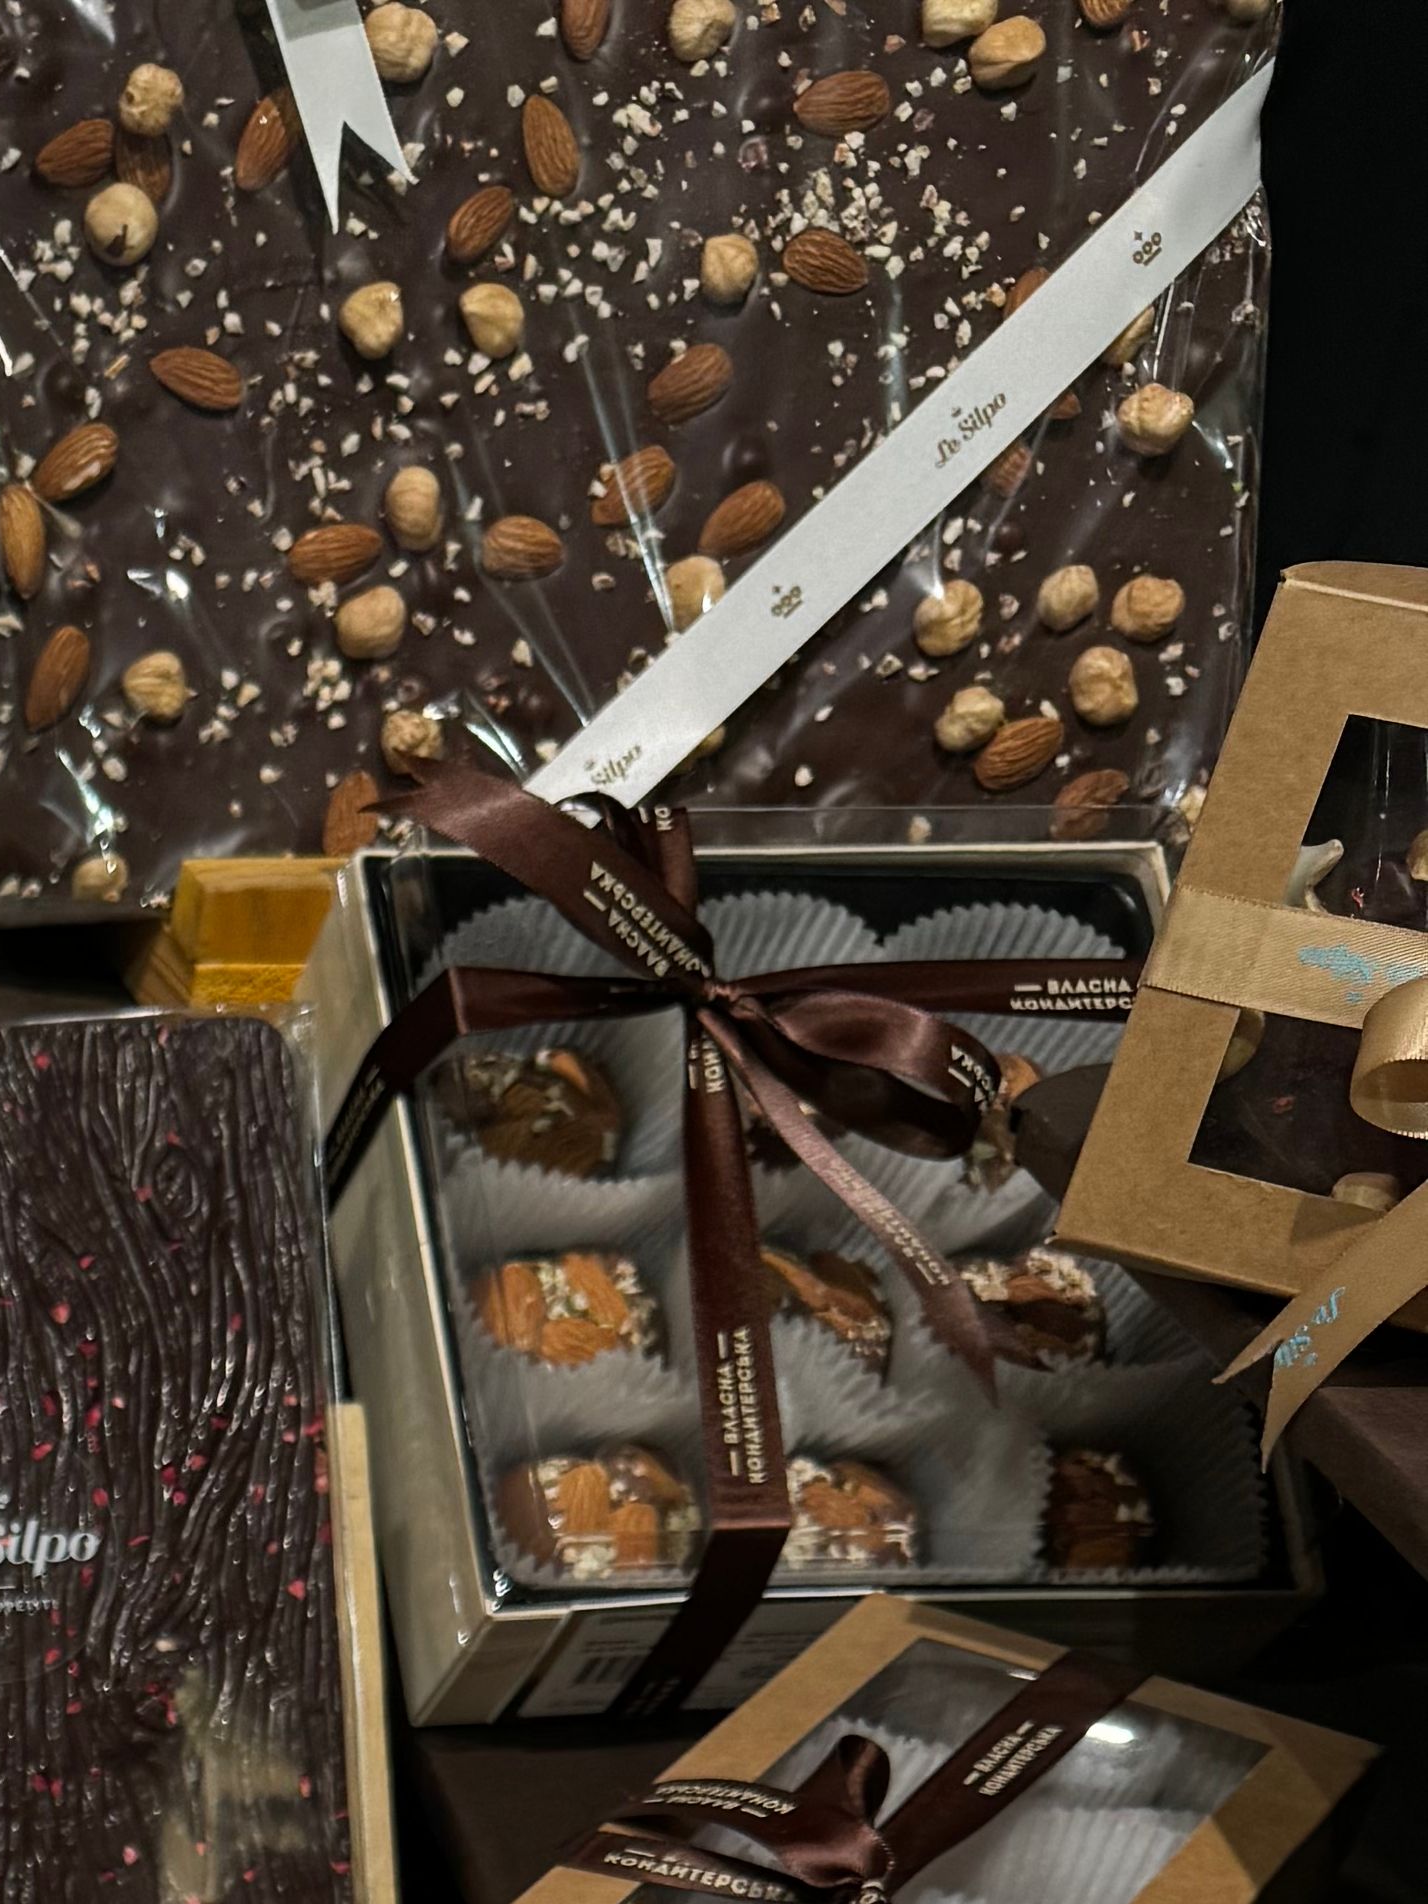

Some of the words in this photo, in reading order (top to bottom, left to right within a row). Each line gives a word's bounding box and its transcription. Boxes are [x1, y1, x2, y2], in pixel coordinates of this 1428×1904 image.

[935, 438, 961, 469] Le
[958, 392, 1006, 442] Silpo
[608, 908, 670, 978] ВЛАСНА
[1047, 978, 1133, 995] ВЛАСНА
[716, 1361, 741, 1444] ВЛАСНА
[733, 1324, 768, 1484] КОНДИТЕРСЬКА
